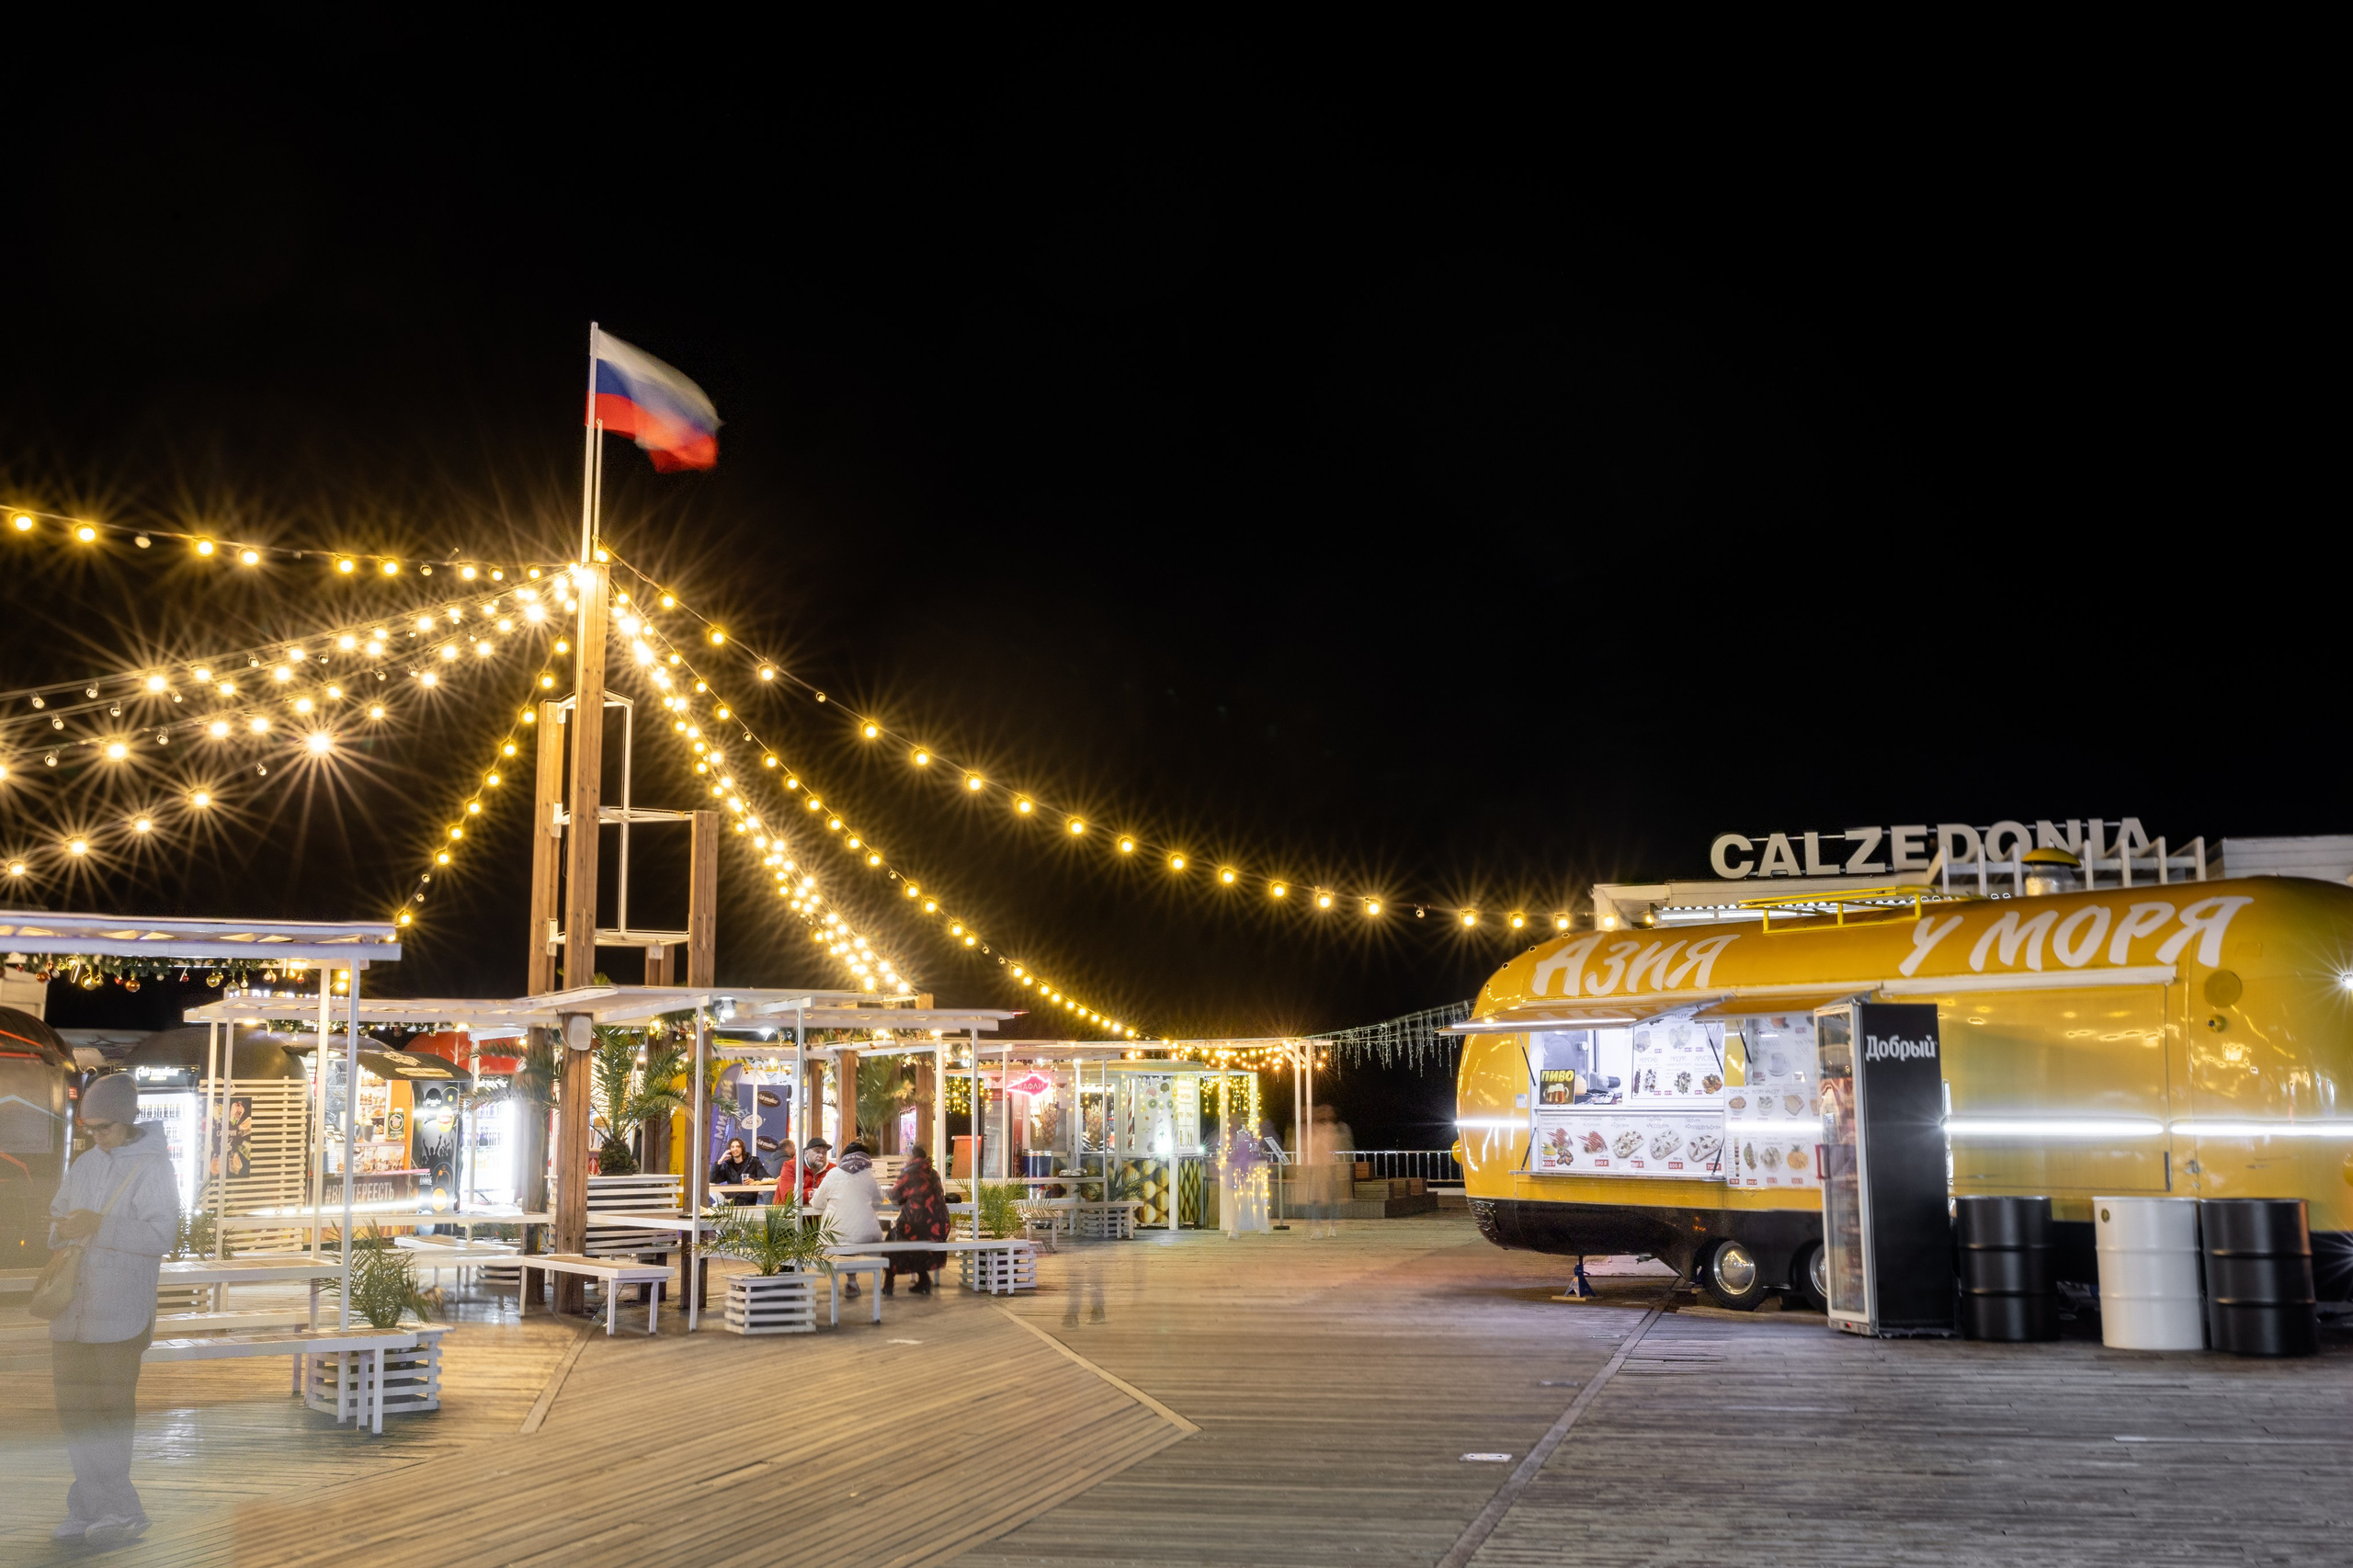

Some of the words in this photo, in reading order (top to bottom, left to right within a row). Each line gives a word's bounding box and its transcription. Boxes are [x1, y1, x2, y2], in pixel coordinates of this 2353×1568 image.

[1711, 817, 2150, 879] CALZEDONIA
[1531, 933, 1741, 996] АЗИЯ
[1899, 914, 1963, 977] У
[1969, 895, 2254, 971] МОРЯ
[1865, 1034, 1936, 1062] Добрый
[1017, 1083, 1045, 1091] ВАФЛИ
[1540, 1070, 1574, 1082] ПИВО
[324, 1182, 394, 1204] #ВПТЕРЕЕСТЬ
